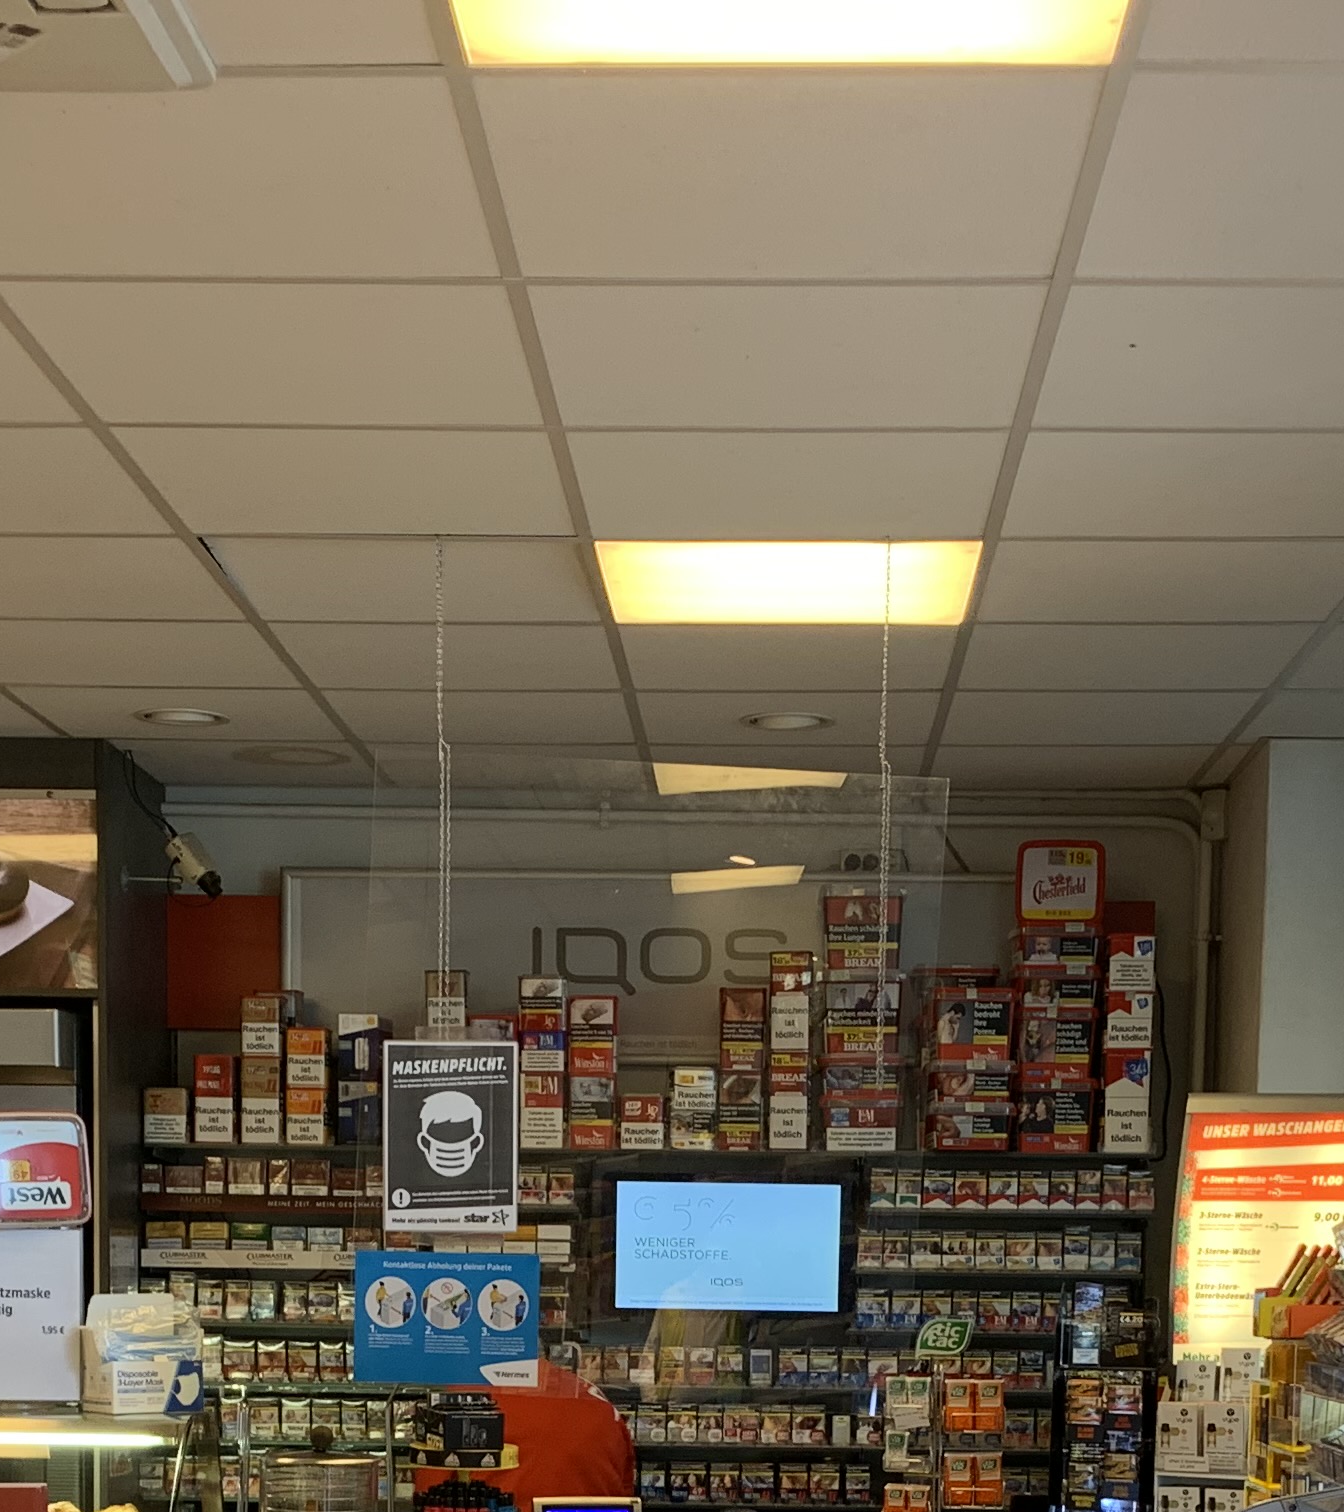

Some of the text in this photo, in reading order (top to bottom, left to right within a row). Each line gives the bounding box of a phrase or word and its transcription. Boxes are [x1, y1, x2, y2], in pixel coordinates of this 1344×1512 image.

[1033, 876, 1086, 904] Chesterfield
[532, 926, 788, 996] IQOS
[974, 1001, 1002, 1011] Rauchen
[974, 1011, 1000, 1019] bedroht
[242, 1026, 278, 1034] Rauchen
[1111, 1025, 1148, 1033] Rauchen
[775, 1031, 804, 1039] tödlich
[1120, 1033, 1149, 1042] tödlich
[246, 1042, 274, 1050] tödlich
[392, 1057, 506, 1075] MASKENPFLICHT.
[292, 1074, 320, 1082] tödlich
[771, 1074, 807, 1082] BREAK
[770, 1107, 807, 1115] Rauchen
[1107, 1109, 1147, 1117] Rauchen
[287, 1117, 322, 1125] Rauchen
[245, 1126, 274, 1134] tödlich
[1121, 1122, 1132, 1130] ist
[1203, 1122, 1250, 1139] UNSER
[290, 1133, 318, 1142] tödlich
[1111, 1134, 1142, 1143] tödlich
[1312, 1175, 1344, 1187] 11,00
[9, 1186, 66, 1206] West
[463, 1213, 490, 1223] star
[1314, 1212, 1340, 1222] 9,00
[634, 1237, 695, 1248] WENIGER
[160, 1251, 208, 1261] CLUBMASTER
[246, 1252, 294, 1262] CLUBMASTER
[634, 1249, 732, 1261] SCHADSTOFFE.
[383, 1260, 512, 1272] Kontaktlose Abholung deiner Pakete
[710, 1277, 744, 1287] IQOS
[42, 1326, 65, 1334] 1,95 €
[932, 1322, 963, 1338] tic
[927, 1333, 960, 1349] tac
[1183, 1352, 1210, 1361] Mehr
[117, 1370, 159, 1379] Disposable
[117, 1378, 164, 1388] 3-Layer Mask
